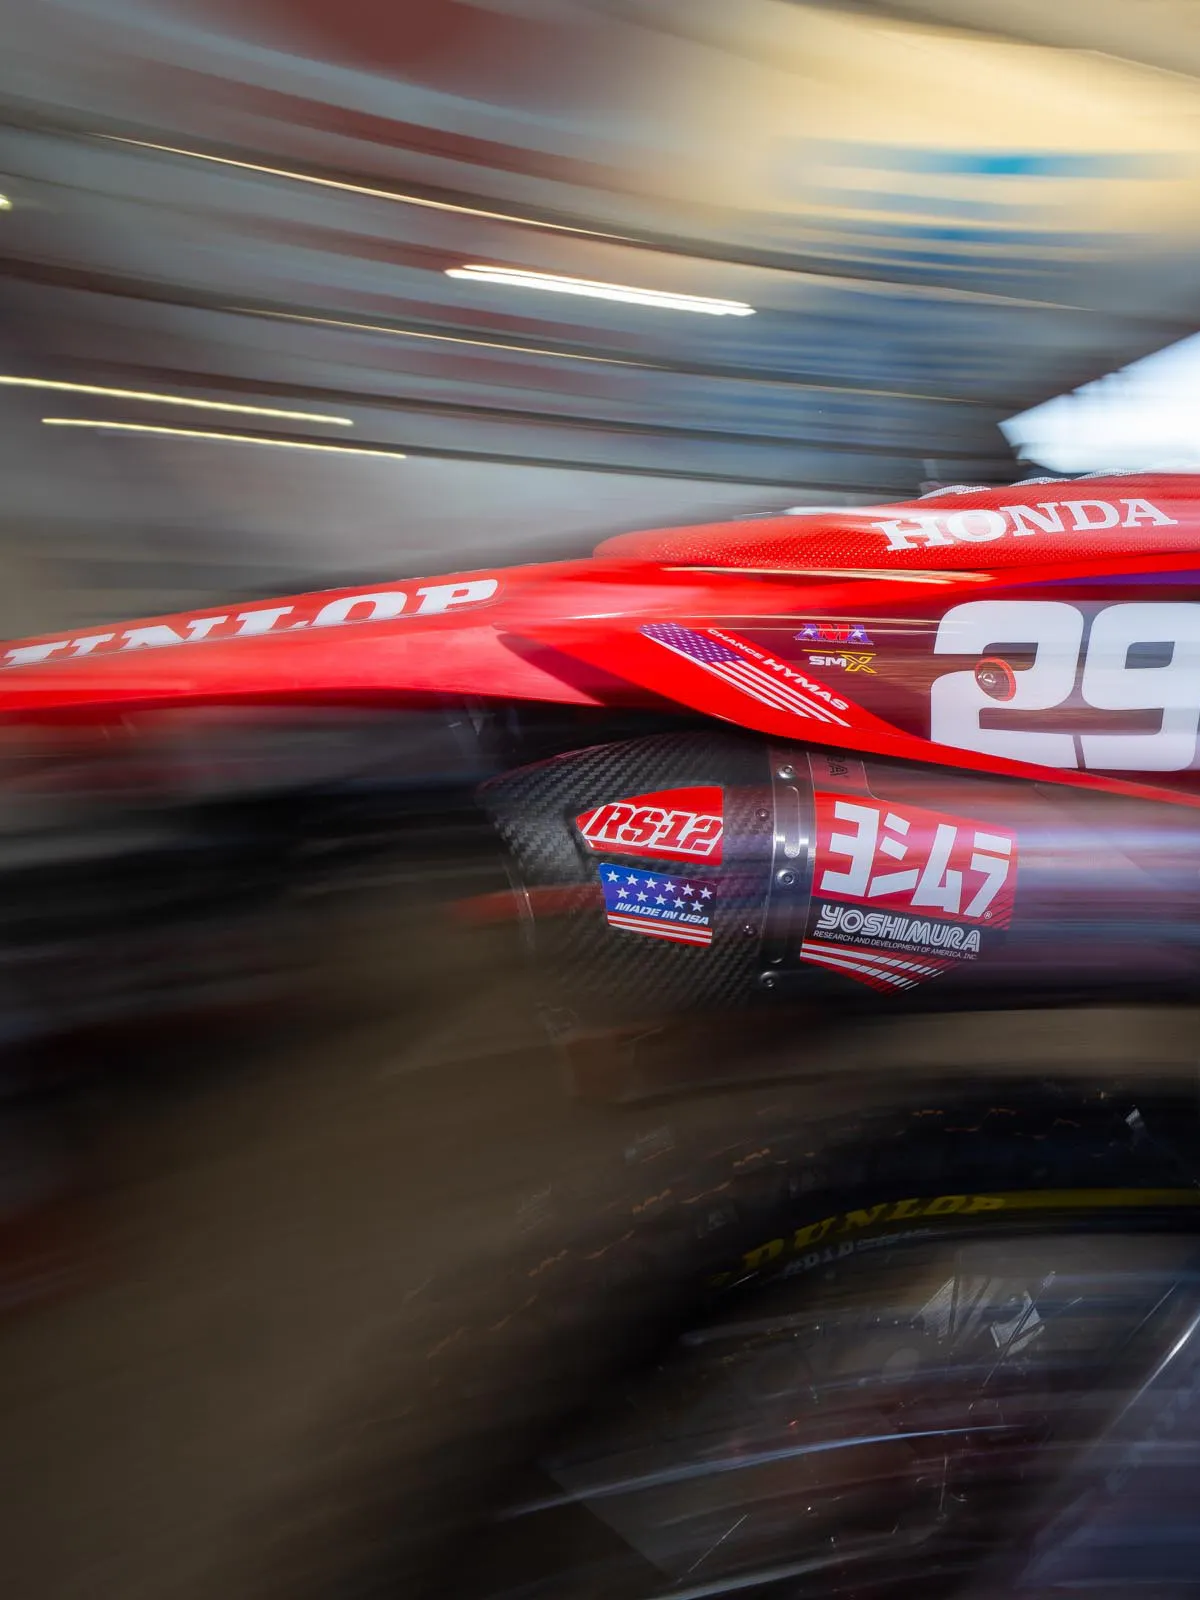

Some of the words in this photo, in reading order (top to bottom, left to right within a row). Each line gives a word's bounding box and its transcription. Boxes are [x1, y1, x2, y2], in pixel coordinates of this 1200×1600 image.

[871, 499, 1178, 551] HONDA
[793, 624, 875, 646] AMA
[707, 629, 765, 659] CHANCE
[762, 659, 849, 711] HYMAS
[809, 654, 878, 674] SMX
[820, 801, 1012, 918] ヨシムラ
[615, 902, 660, 917] MADE
[661, 909, 677, 920] IN
[679, 913, 709, 925] USA
[816, 904, 981, 952] YOSHIMURA
[813, 930, 853, 945] RESEARCH
[853, 937, 870, 946] AND
[870, 939, 920, 953] DEVELOPMENT
